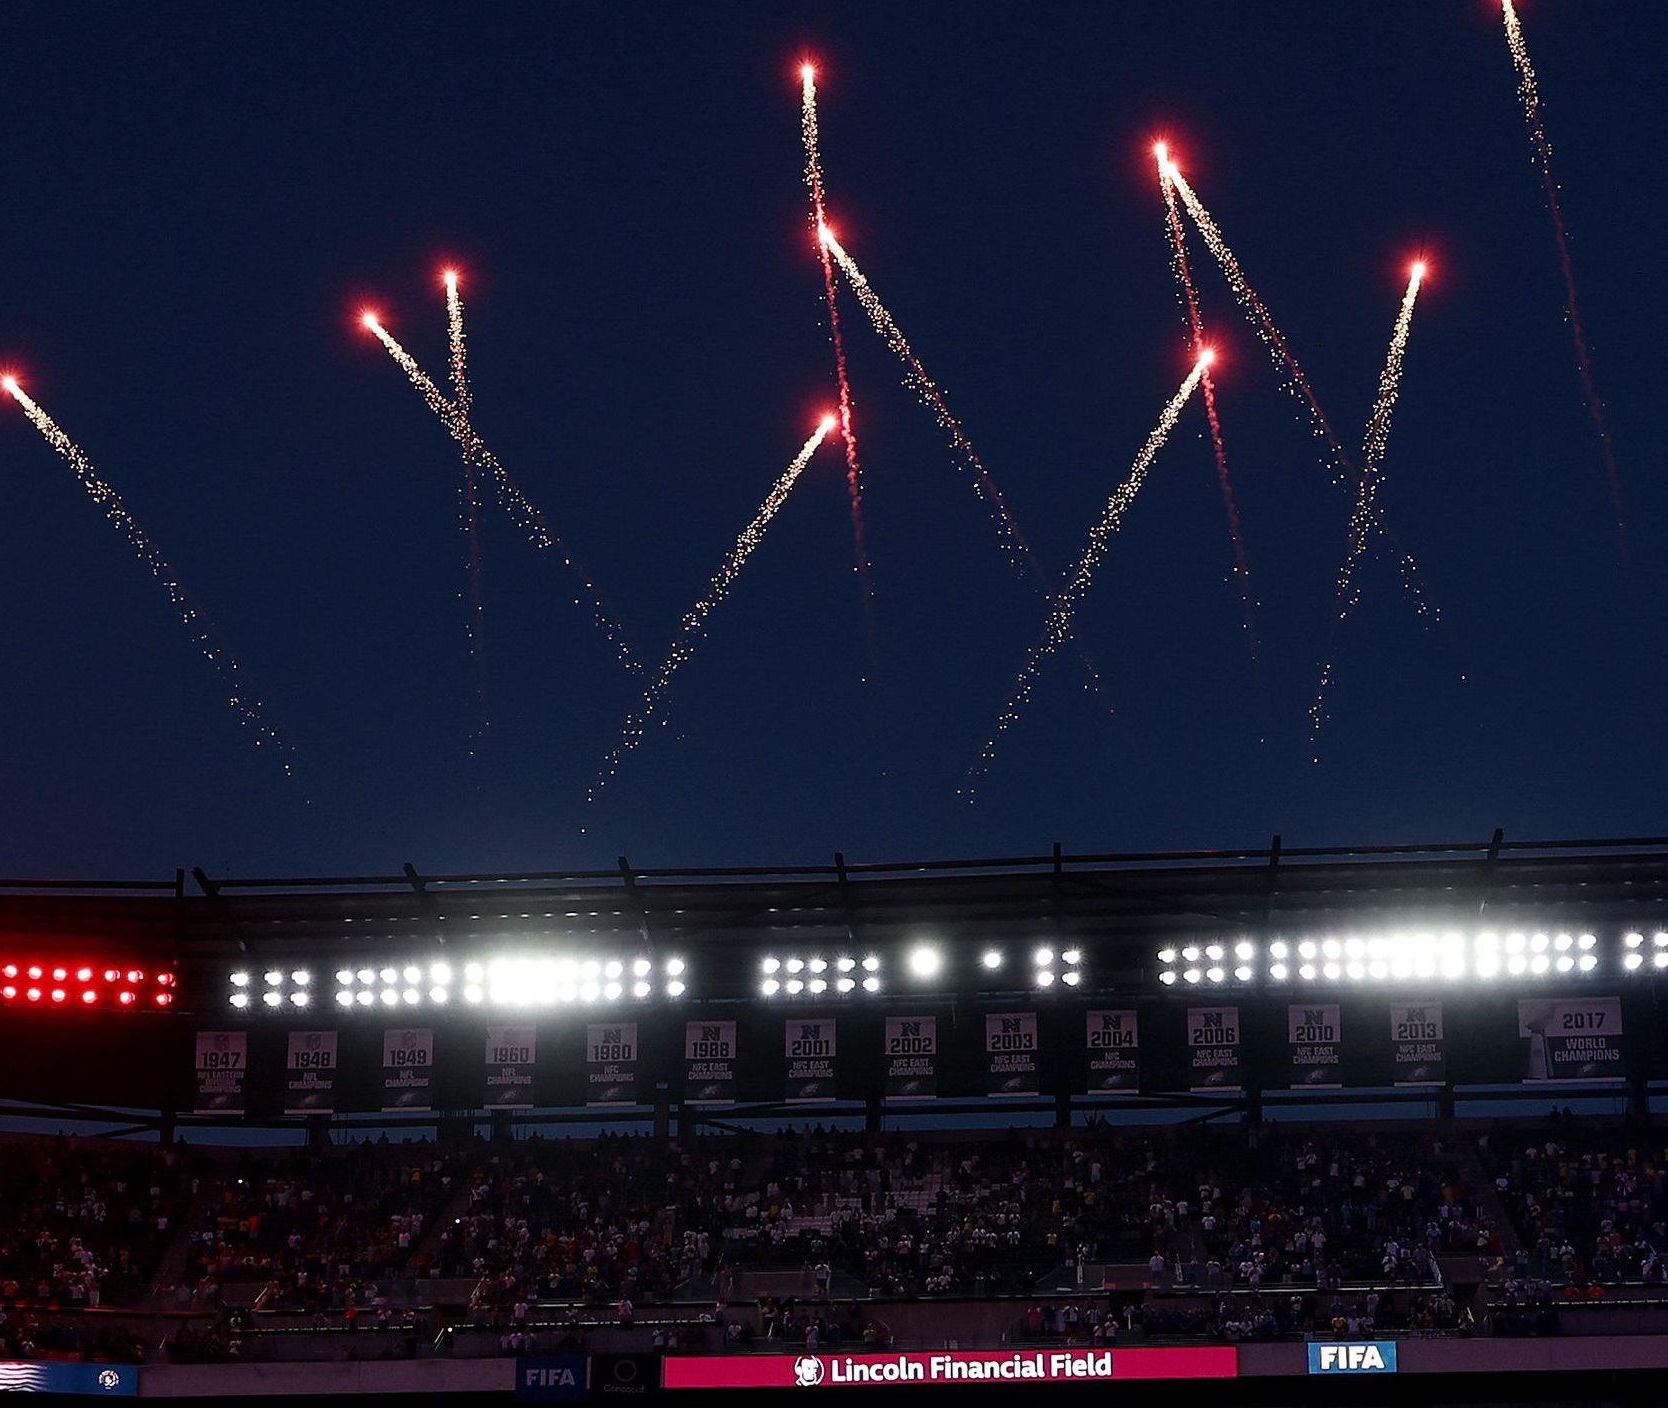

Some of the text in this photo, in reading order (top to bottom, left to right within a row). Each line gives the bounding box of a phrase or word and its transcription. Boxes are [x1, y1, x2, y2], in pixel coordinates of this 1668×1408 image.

[1563, 1013, 1605, 1029] 2017
[1091, 1031, 1132, 1046] 2004
[1194, 1028, 1235, 1044] 2006
[1296, 1026, 1333, 1041] 2010
[1398, 1023, 1436, 1039] 2013
[792, 1040, 830, 1056] 2001
[891, 1037, 932, 1053] 2002
[991, 1033, 1032, 1050] 2003
[1566, 1038, 1606, 1049] WORLD
[390, 1050, 427, 1065] 1949
[594, 1045, 631, 1061] 1980
[693, 1042, 729, 1058] 1988
[1214, 1049, 1233, 1058] EAST
[1554, 1049, 1620, 1061] CHAMPIONS
[202, 1052, 241, 1068] 1947
[294, 1052, 330, 1068] 1948
[810, 1060, 829, 1069] EAST
[1090, 1059, 1136, 1070] CHAMPIONS
[1193, 1057, 1238, 1067] CHAMPIONS
[1293, 1054, 1339, 1064] CHAMPIONS
[789, 1068, 833, 1079] CHAMPIONS
[888, 1066, 934, 1077] CHAMPIONS
[991, 1063, 1035, 1073] CHAMPIONS
[1321, 1346, 1385, 1370] FIFA
[832, 1352, 1112, 1382] Lincoln Financial Field
[526, 1368, 575, 1386] FIFA
